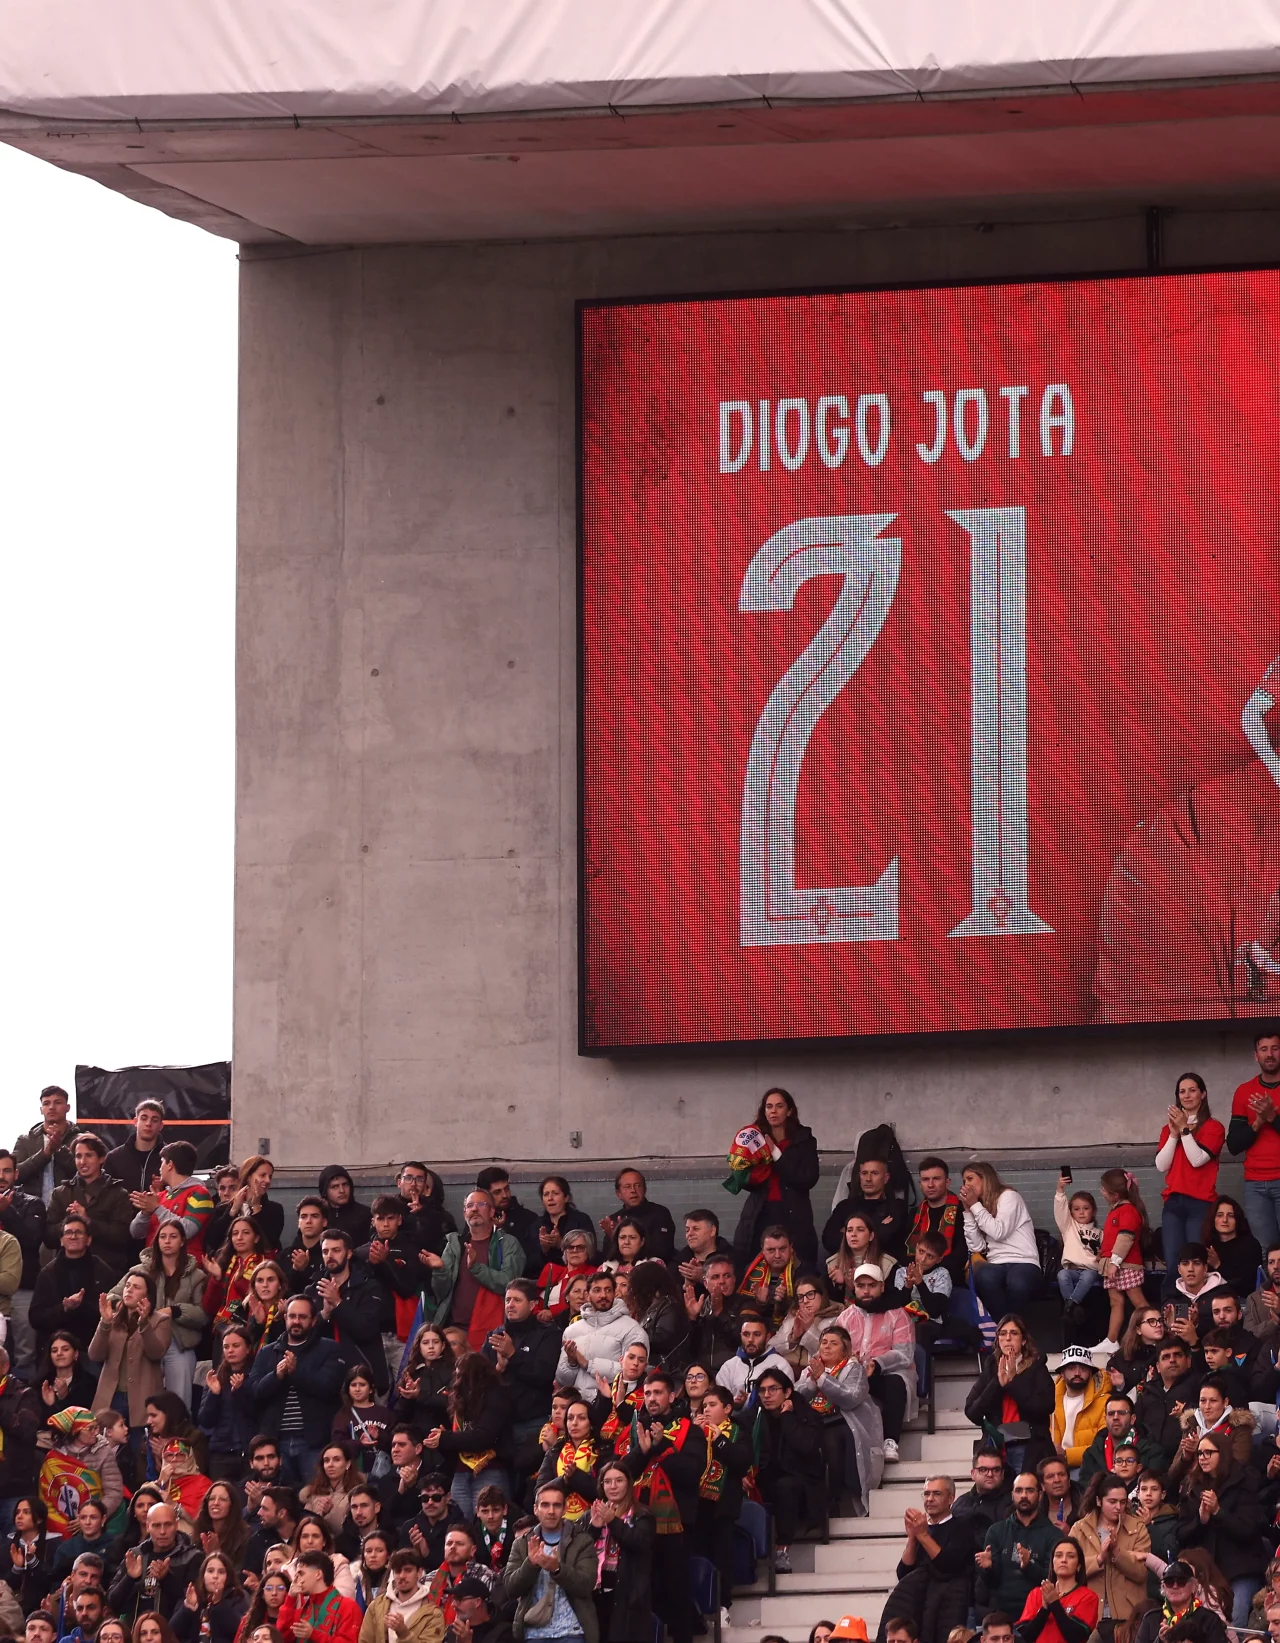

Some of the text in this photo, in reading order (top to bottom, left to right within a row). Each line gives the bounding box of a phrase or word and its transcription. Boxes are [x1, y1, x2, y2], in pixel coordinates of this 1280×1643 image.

[719, 383, 1076, 474] DIOGO JOTA
[738, 506, 1056, 947] 21
